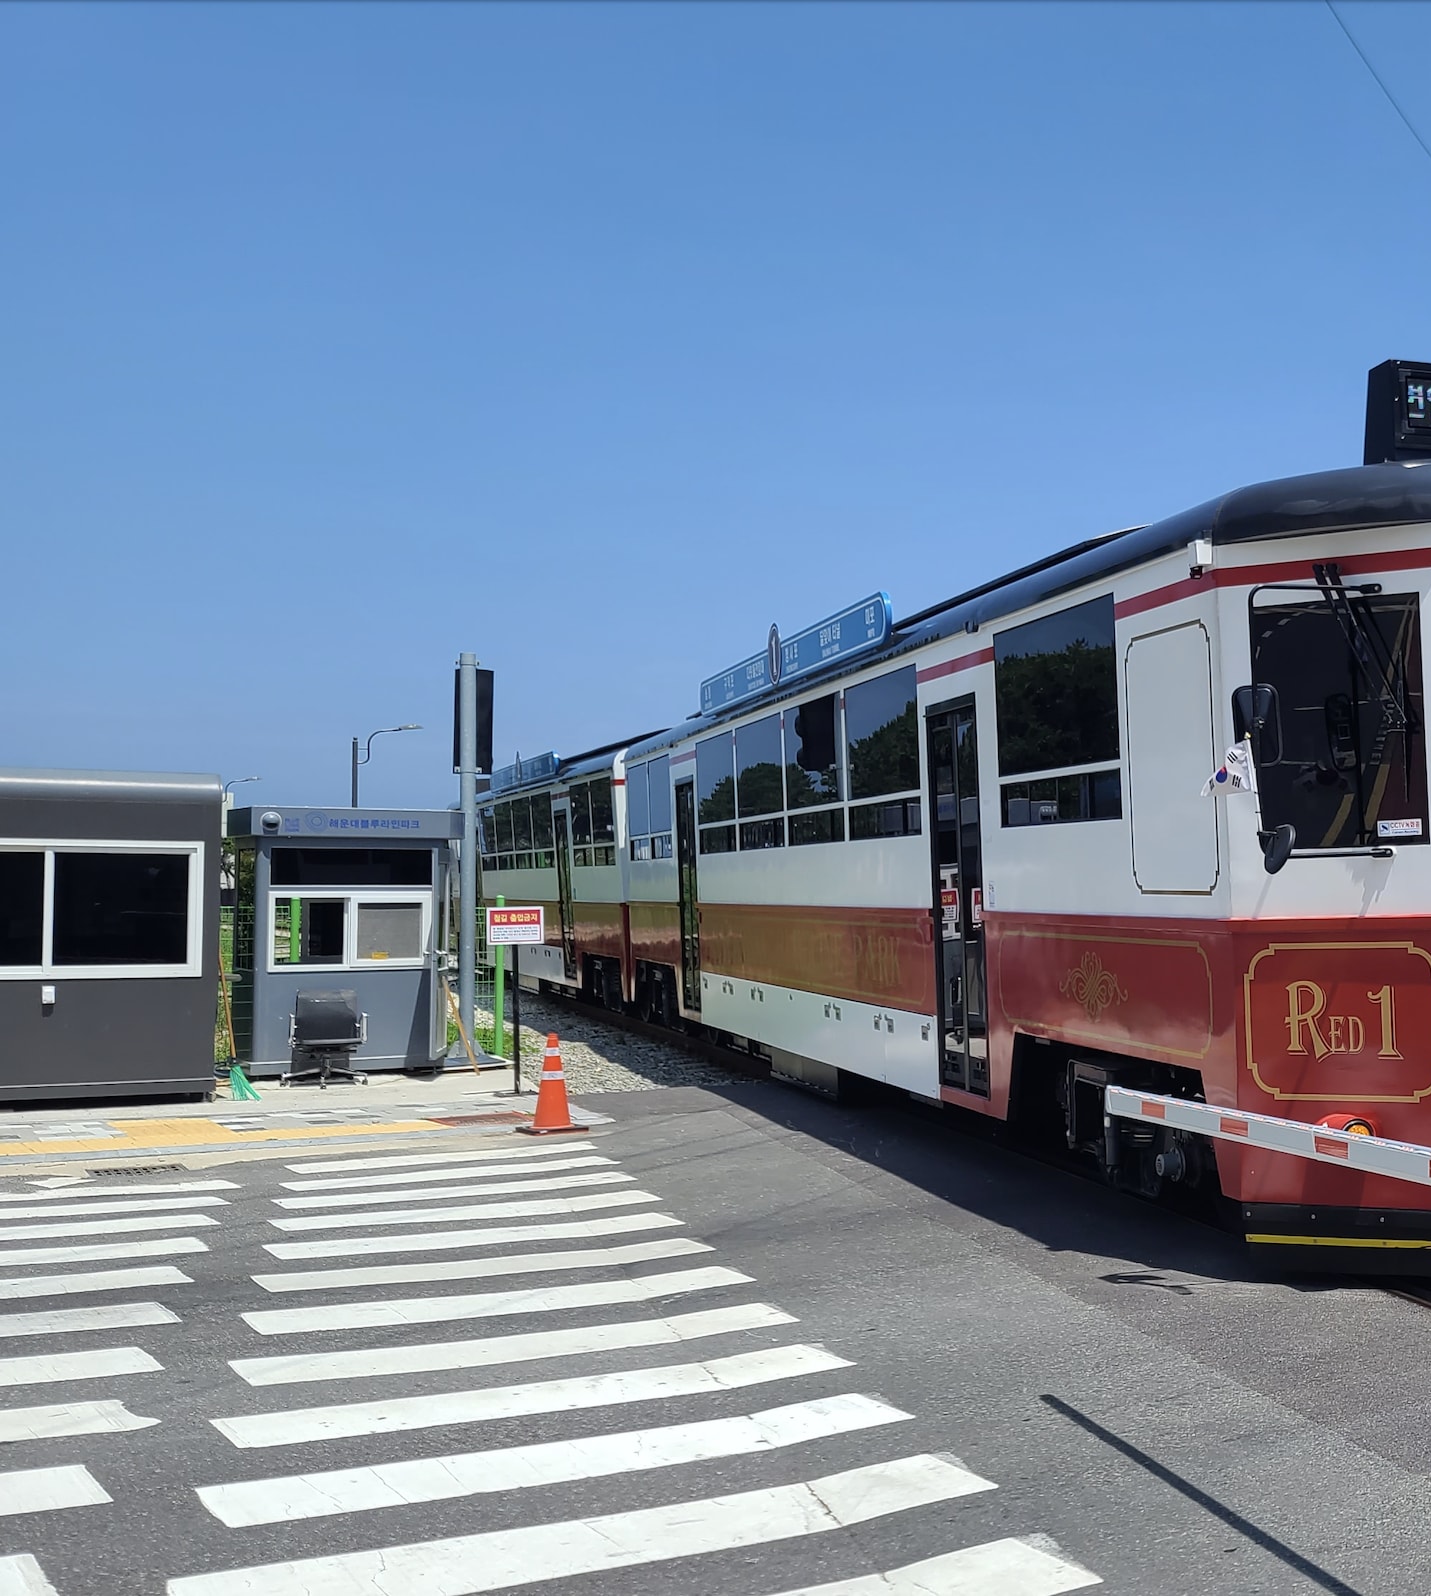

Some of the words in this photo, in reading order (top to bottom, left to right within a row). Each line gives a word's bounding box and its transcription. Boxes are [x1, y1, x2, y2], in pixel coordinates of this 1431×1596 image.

[329, 818, 421, 829] 해운대블루라인파크
[510, 913, 538, 923] 출입금지
[1367, 985, 1404, 1060] 1
